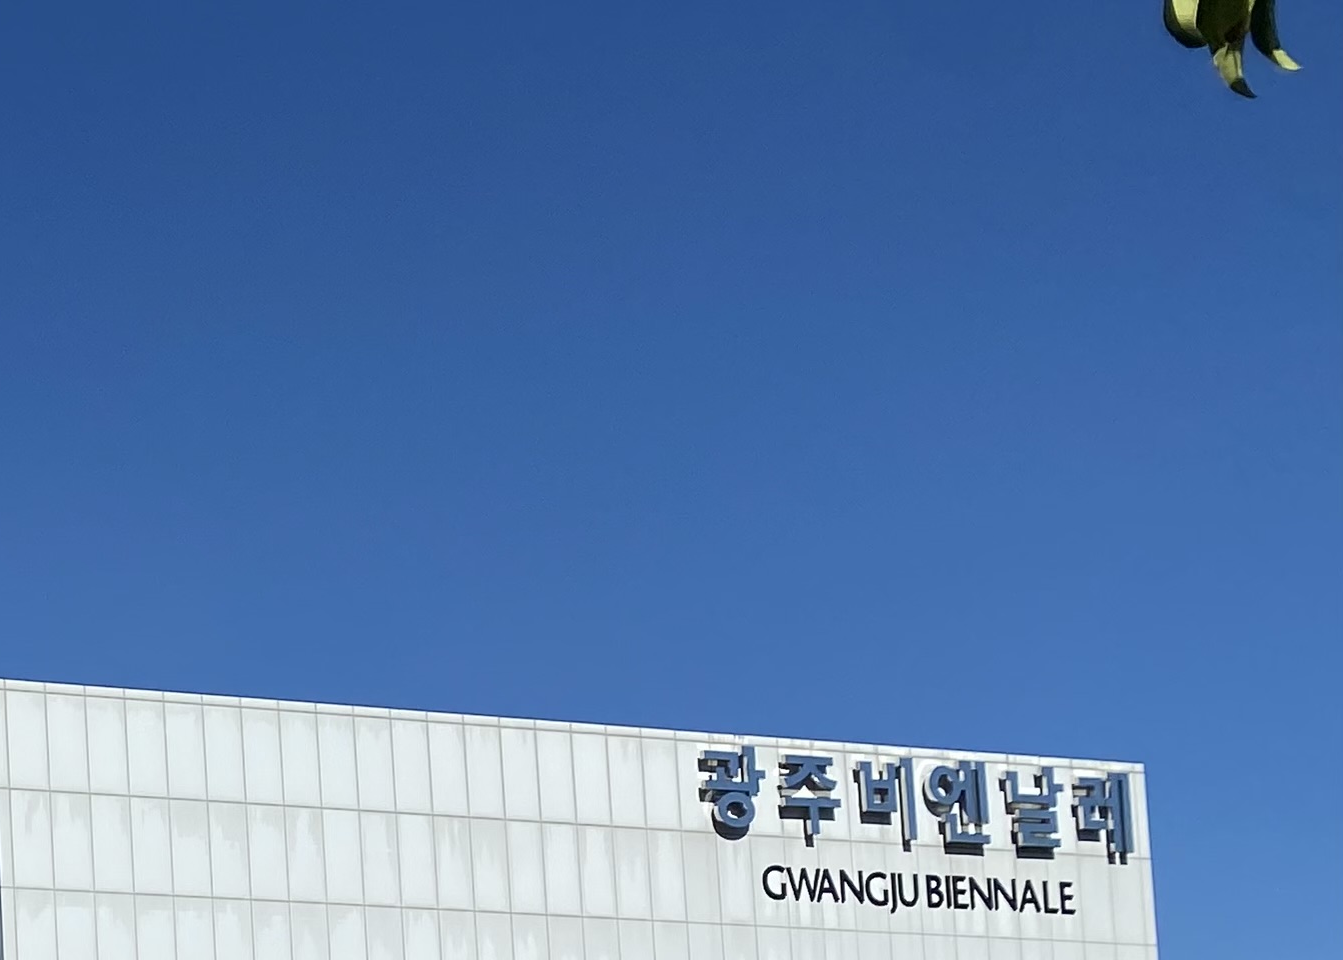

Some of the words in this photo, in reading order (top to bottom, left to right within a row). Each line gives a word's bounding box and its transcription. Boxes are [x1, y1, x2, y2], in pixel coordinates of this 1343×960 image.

[699, 746, 1135, 858] 광주비엔날레
[762, 864, 920, 915] GWANGJU
[929, 873, 1077, 916] BIENNALE
